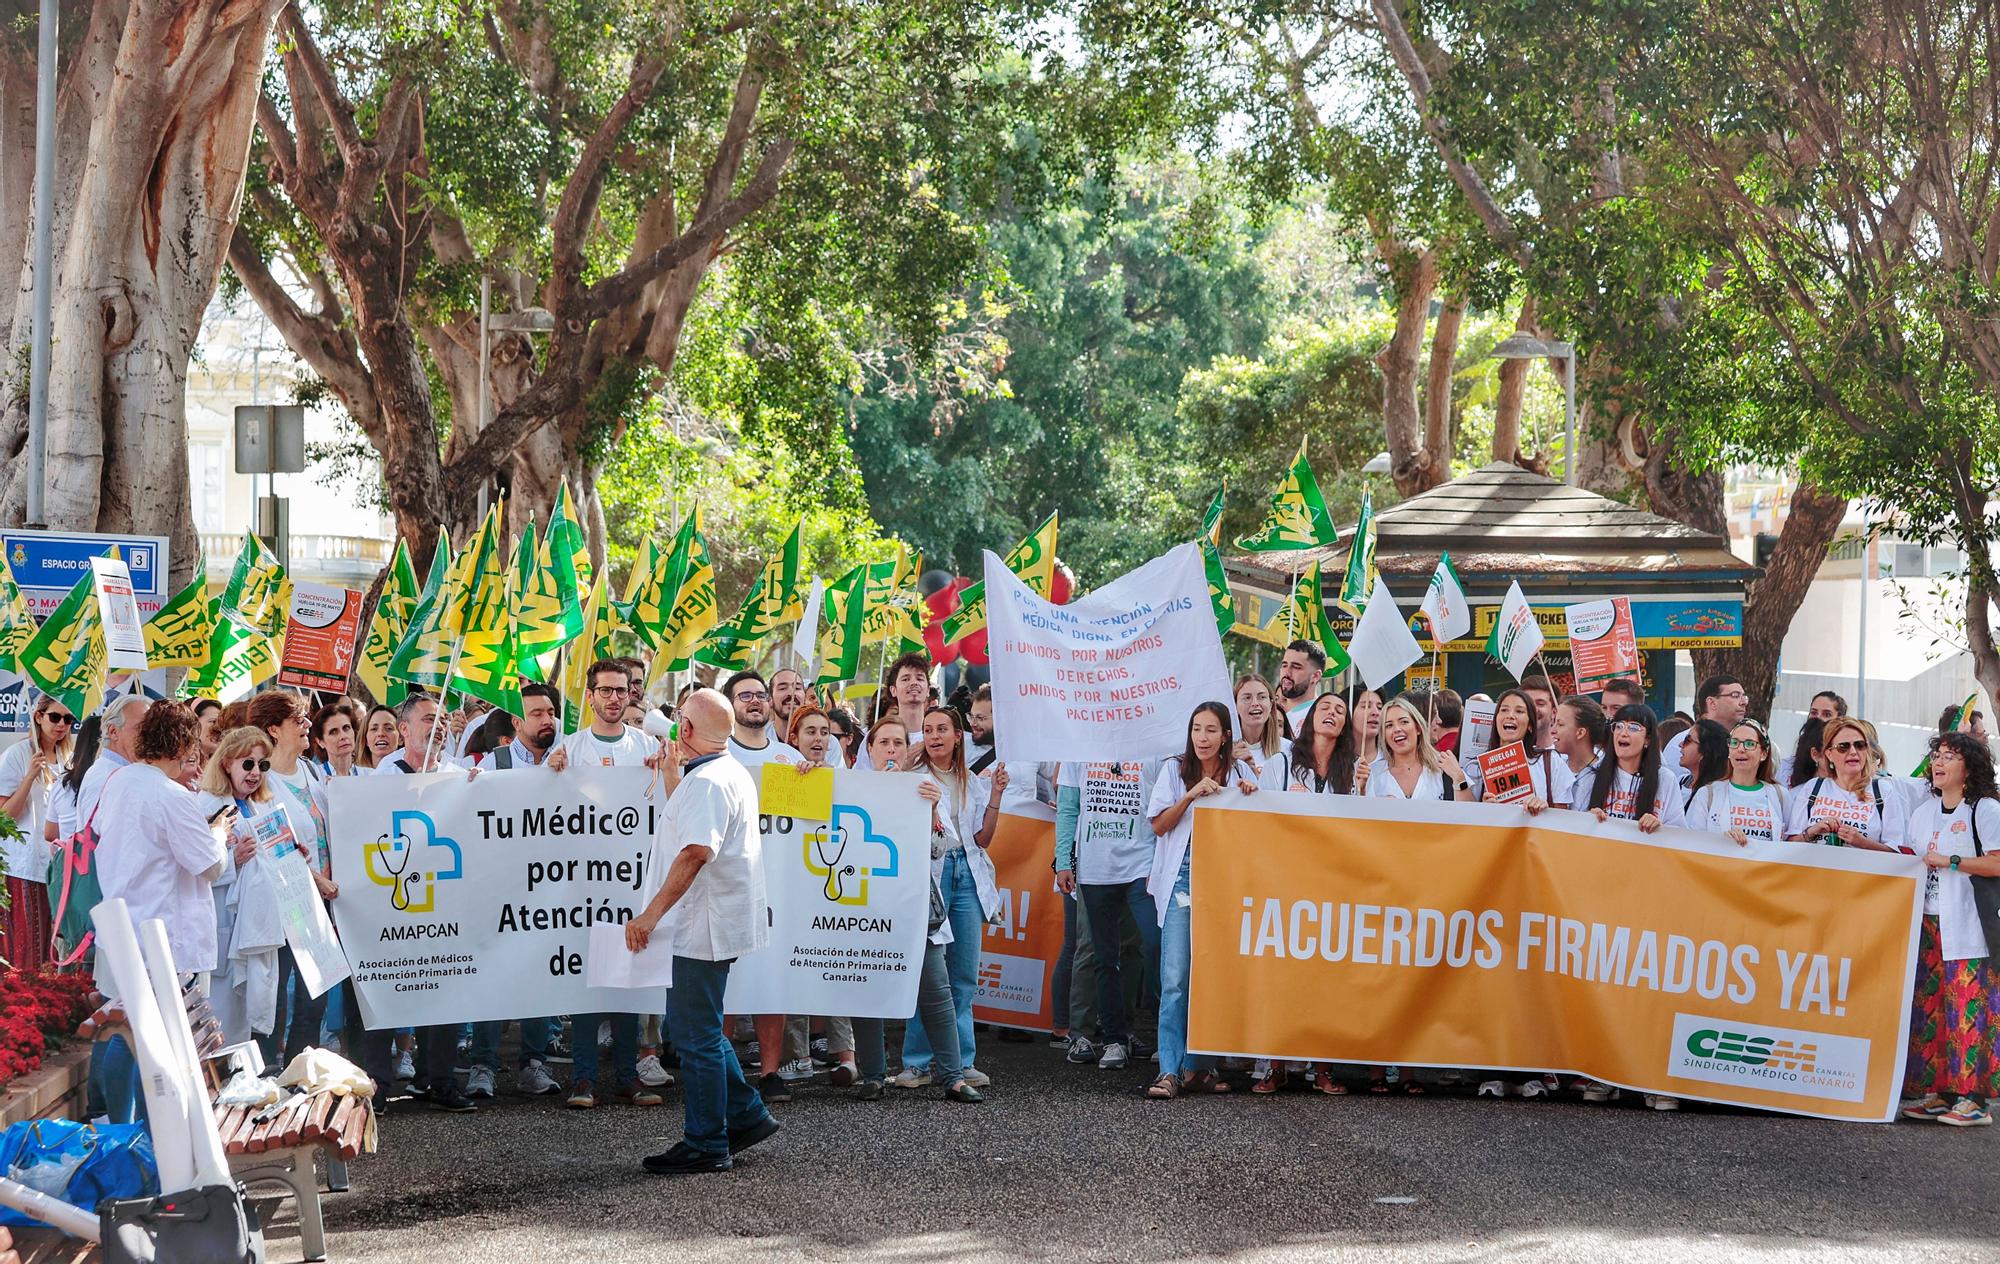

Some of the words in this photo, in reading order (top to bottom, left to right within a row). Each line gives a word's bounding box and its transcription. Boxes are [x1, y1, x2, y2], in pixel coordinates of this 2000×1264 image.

[42, 558, 76, 570] ESPACIO
[78, 560, 91, 570] GR
[135, 555, 143, 566] 3
[137, 600, 161, 611] RTÍN
[1121, 627, 1138, 638] EN
[1018, 641, 1061, 661] UNIDOS
[1072, 649, 1097, 662] POR
[1704, 639, 1737, 647] MIGUEL
[1019, 683, 1067, 702] UNIDOS
[1074, 690, 1101, 703] POR
[1066, 705, 1143, 723] PACIENTES
[1487, 748, 1517, 766] ¡HUELGA!
[1111, 782, 1139, 791] UNAS
[1493, 777, 1508, 794] 19
[1087, 797, 1140, 807] ABORALES
[477, 810, 513, 840] Tu
[522, 804, 640, 838] Médic@
[527, 858, 579, 892] por
[586, 852, 644, 890] mej
[498, 897, 634, 934] Atención
[987, 887, 1031, 941] A!
[380, 922, 460, 942] AMAPCAN
[811, 916, 892, 933] AMAPCAN
[549, 946, 583, 976] de
[793, 945, 845, 957] Asociación
[846, 947, 859, 958] de
[861, 947, 905, 960] Médicos
[1239, 896, 1505, 970] ¡ACUERDOS
[1517, 911, 1760, 1005] FIRMADOS
[1775, 948, 1853, 1017] YA!
[358, 956, 415, 970] Asociación
[417, 954, 430, 966] de
[431, 953, 474, 965] Médicos
[790, 958, 802, 968] de
[803, 958, 846, 970] Atención
[847, 960, 893, 972] Primaria
[894, 961, 907, 973] de
[356, 972, 369, 983] de
[370, 967, 418, 982] Atención
[419, 966, 463, 979] Primaria
[464, 965, 478, 976] de
[822, 972, 868, 983] Canarias
[394, 981, 440, 993] Canarias
[988, 989, 1034, 1003] CANARIO
[1686, 1029, 1818, 1073] CESM
[1683, 1057, 1747, 1074] SINDICATO
[1751, 1067, 1798, 1082] MÉDICO
[1801, 1075, 1855, 1089] CANARIO
[1815, 1067, 1856, 1078] CANARIAS
